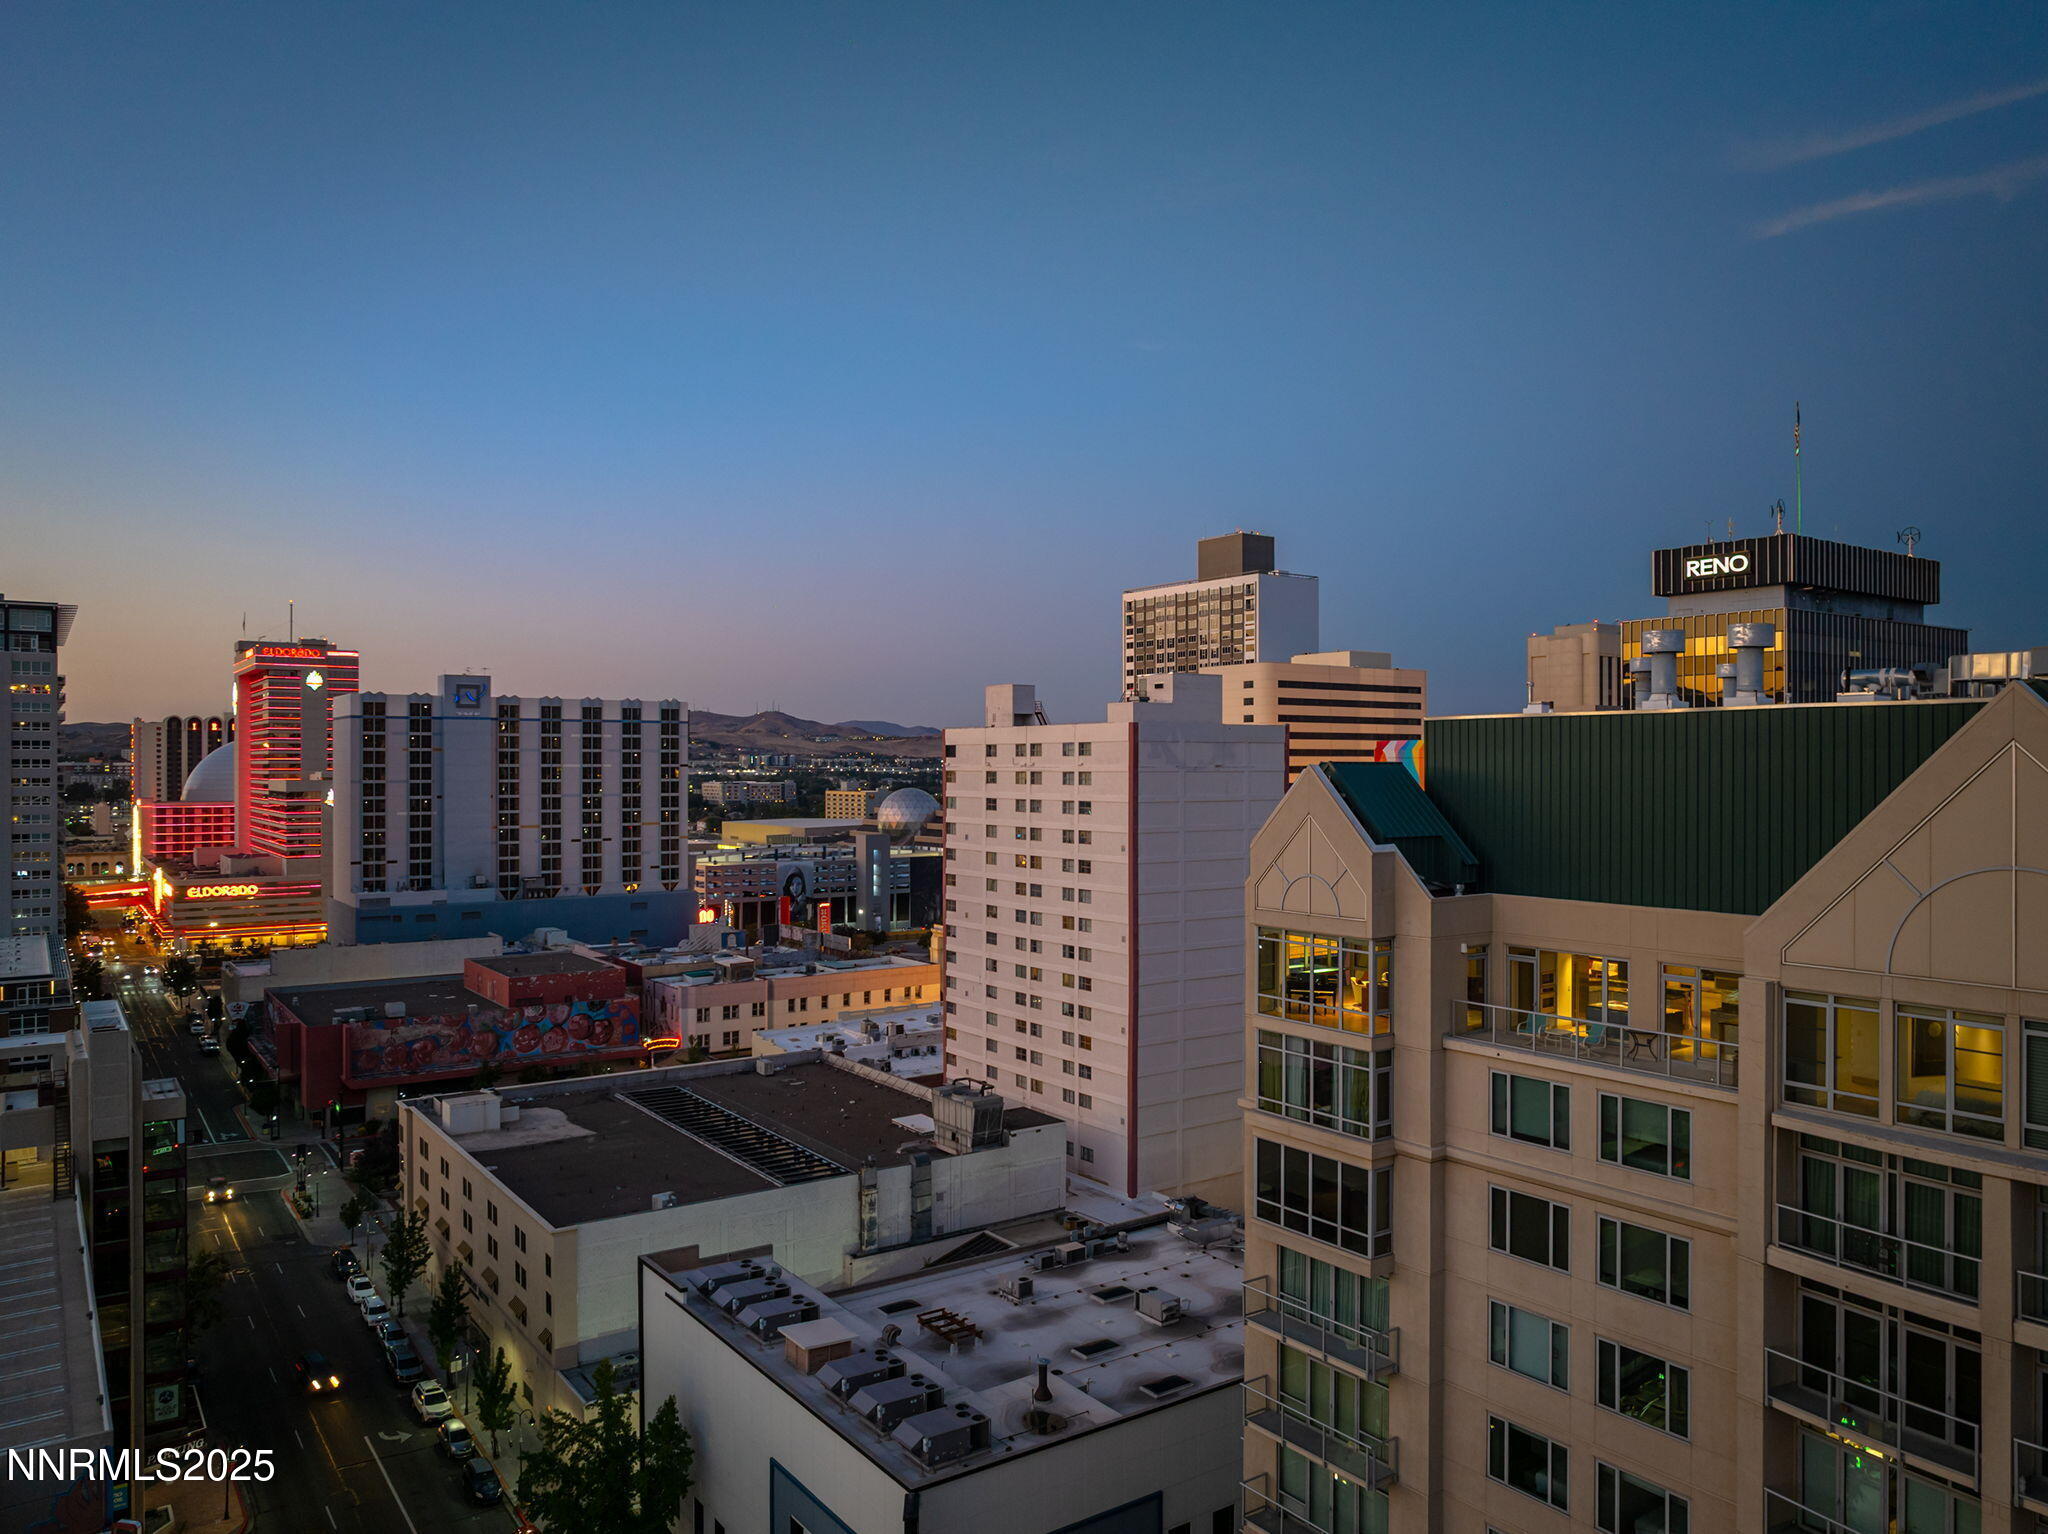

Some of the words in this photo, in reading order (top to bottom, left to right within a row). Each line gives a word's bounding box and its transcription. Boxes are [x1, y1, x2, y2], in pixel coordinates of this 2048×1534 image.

[1686, 554, 1749, 578] RENO
[262, 647, 321, 658] ELDORADO
[186, 884, 259, 898] ELDORADO
[147, 1438, 205, 1465] PRKING
